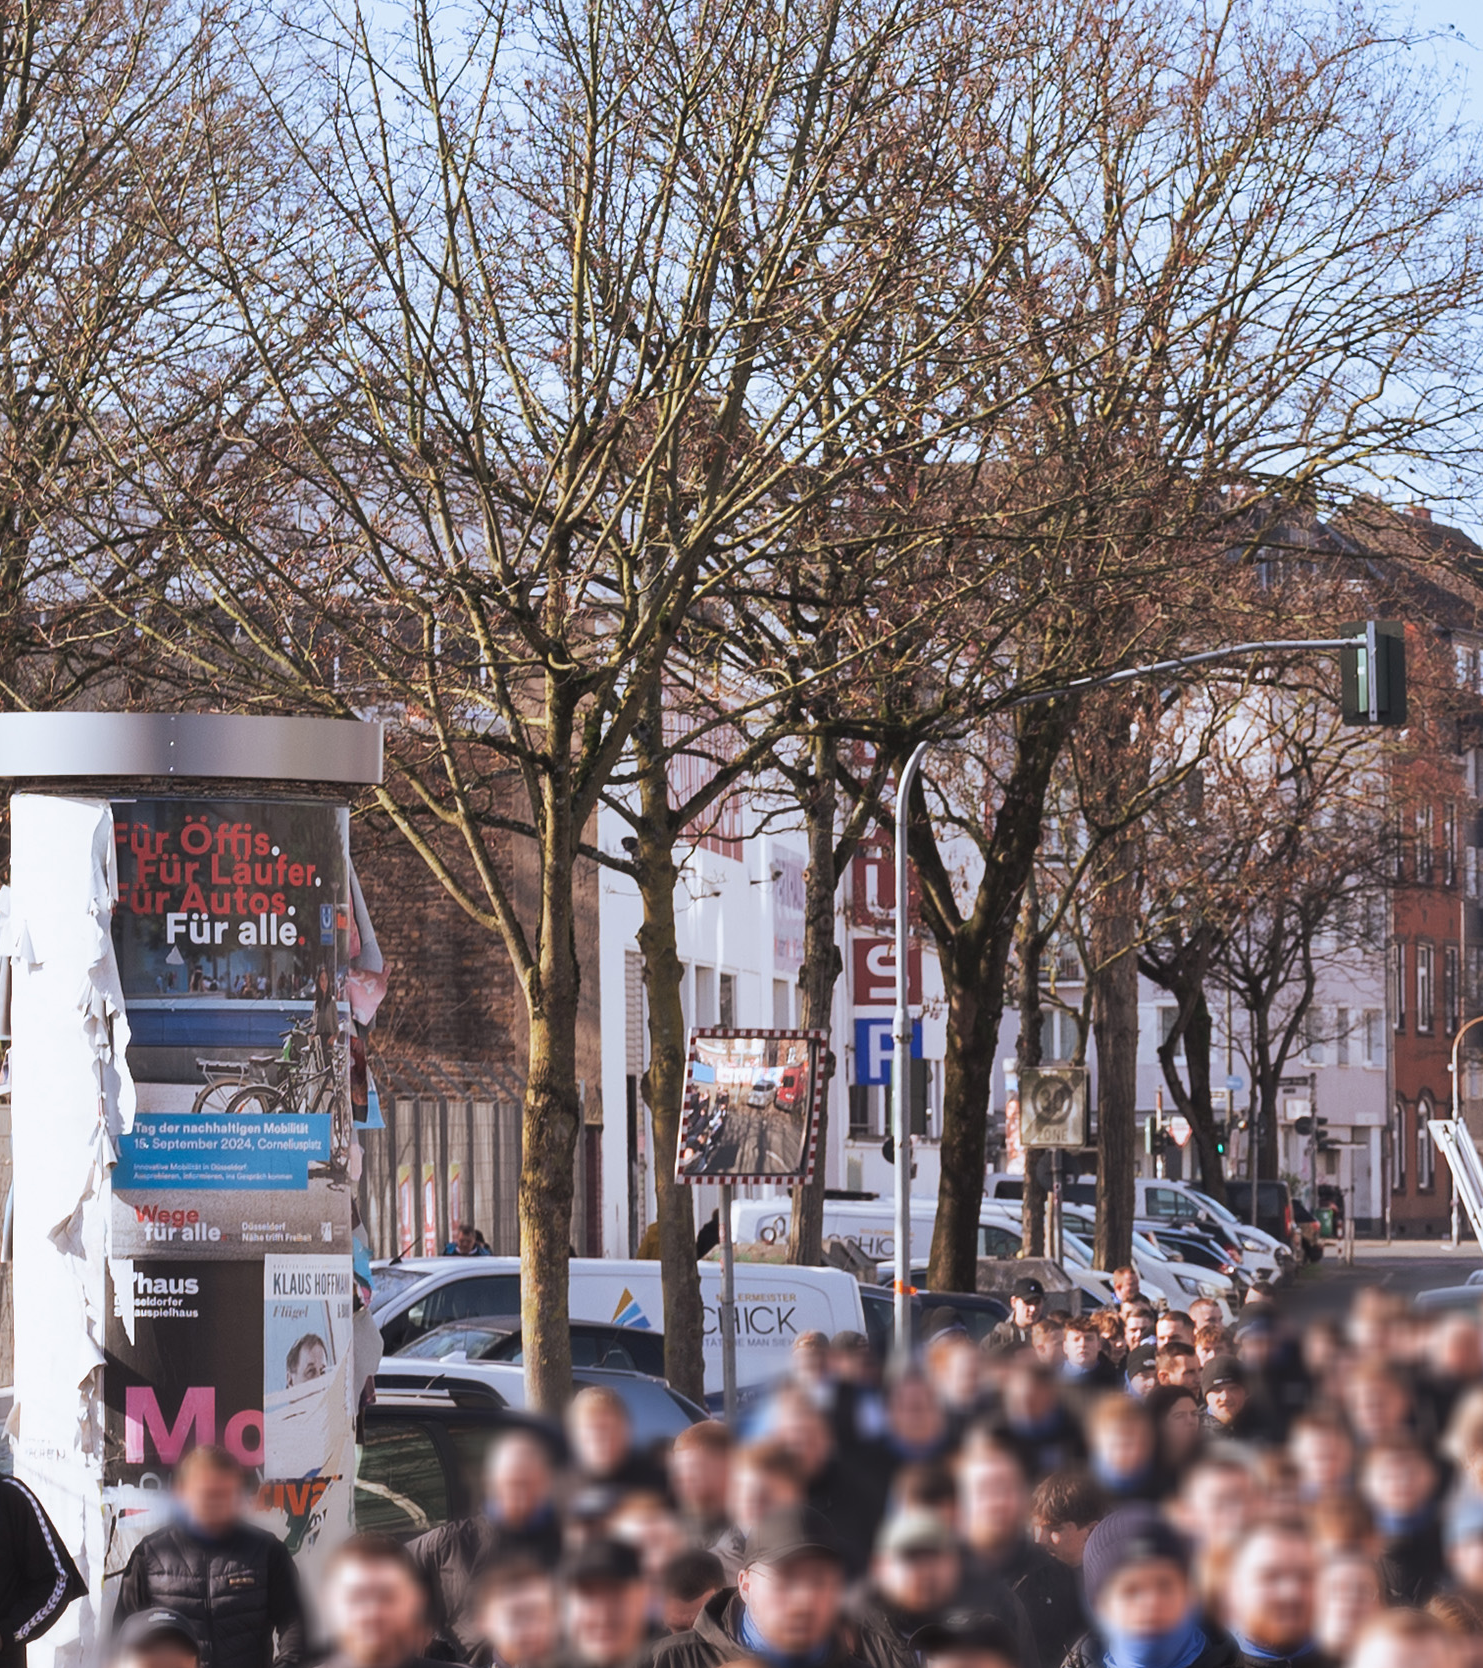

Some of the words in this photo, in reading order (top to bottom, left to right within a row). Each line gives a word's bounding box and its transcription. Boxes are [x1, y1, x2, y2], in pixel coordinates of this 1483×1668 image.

[114, 822, 169, 854] Für
[181, 815, 280, 856] Öffis.
[137, 852, 199, 885] Für
[211, 853, 321, 887] Läufer.
[113, 883, 170, 916] Für
[180, 883, 295, 916] Autos.
[167, 913, 228, 945] Für
[239, 913, 305, 946] alle.
[134, 1122, 155, 1136] Tag
[159, 1122, 180, 1134] der
[183, 1122, 261, 1136] nachhaltigen
[264, 1122, 308, 1134] Mobilität
[152, 1138, 217, 1151] September
[221, 1138, 255, 1151] 2024,
[258, 1138, 322, 1152] Corneliusplatz
[134, 1163, 168, 1171] Innovative
[170, 1163, 201, 1171] Mobilität
[134, 1205, 199, 1227] Wege
[144, 1222, 174, 1242] für
[182, 1222, 226, 1242] alle.
[242, 1222, 286, 1232] Düsseldorf
[242, 1233, 264, 1242] Nähe
[273, 1273, 311, 1295] KLAUS
[114, 1307, 199, 1319] Sauspielhaus
[273, 1304, 308, 1320] Flügel
[703, 1306, 798, 1334] CHICK
[747, 1338, 769, 1348] MAN
